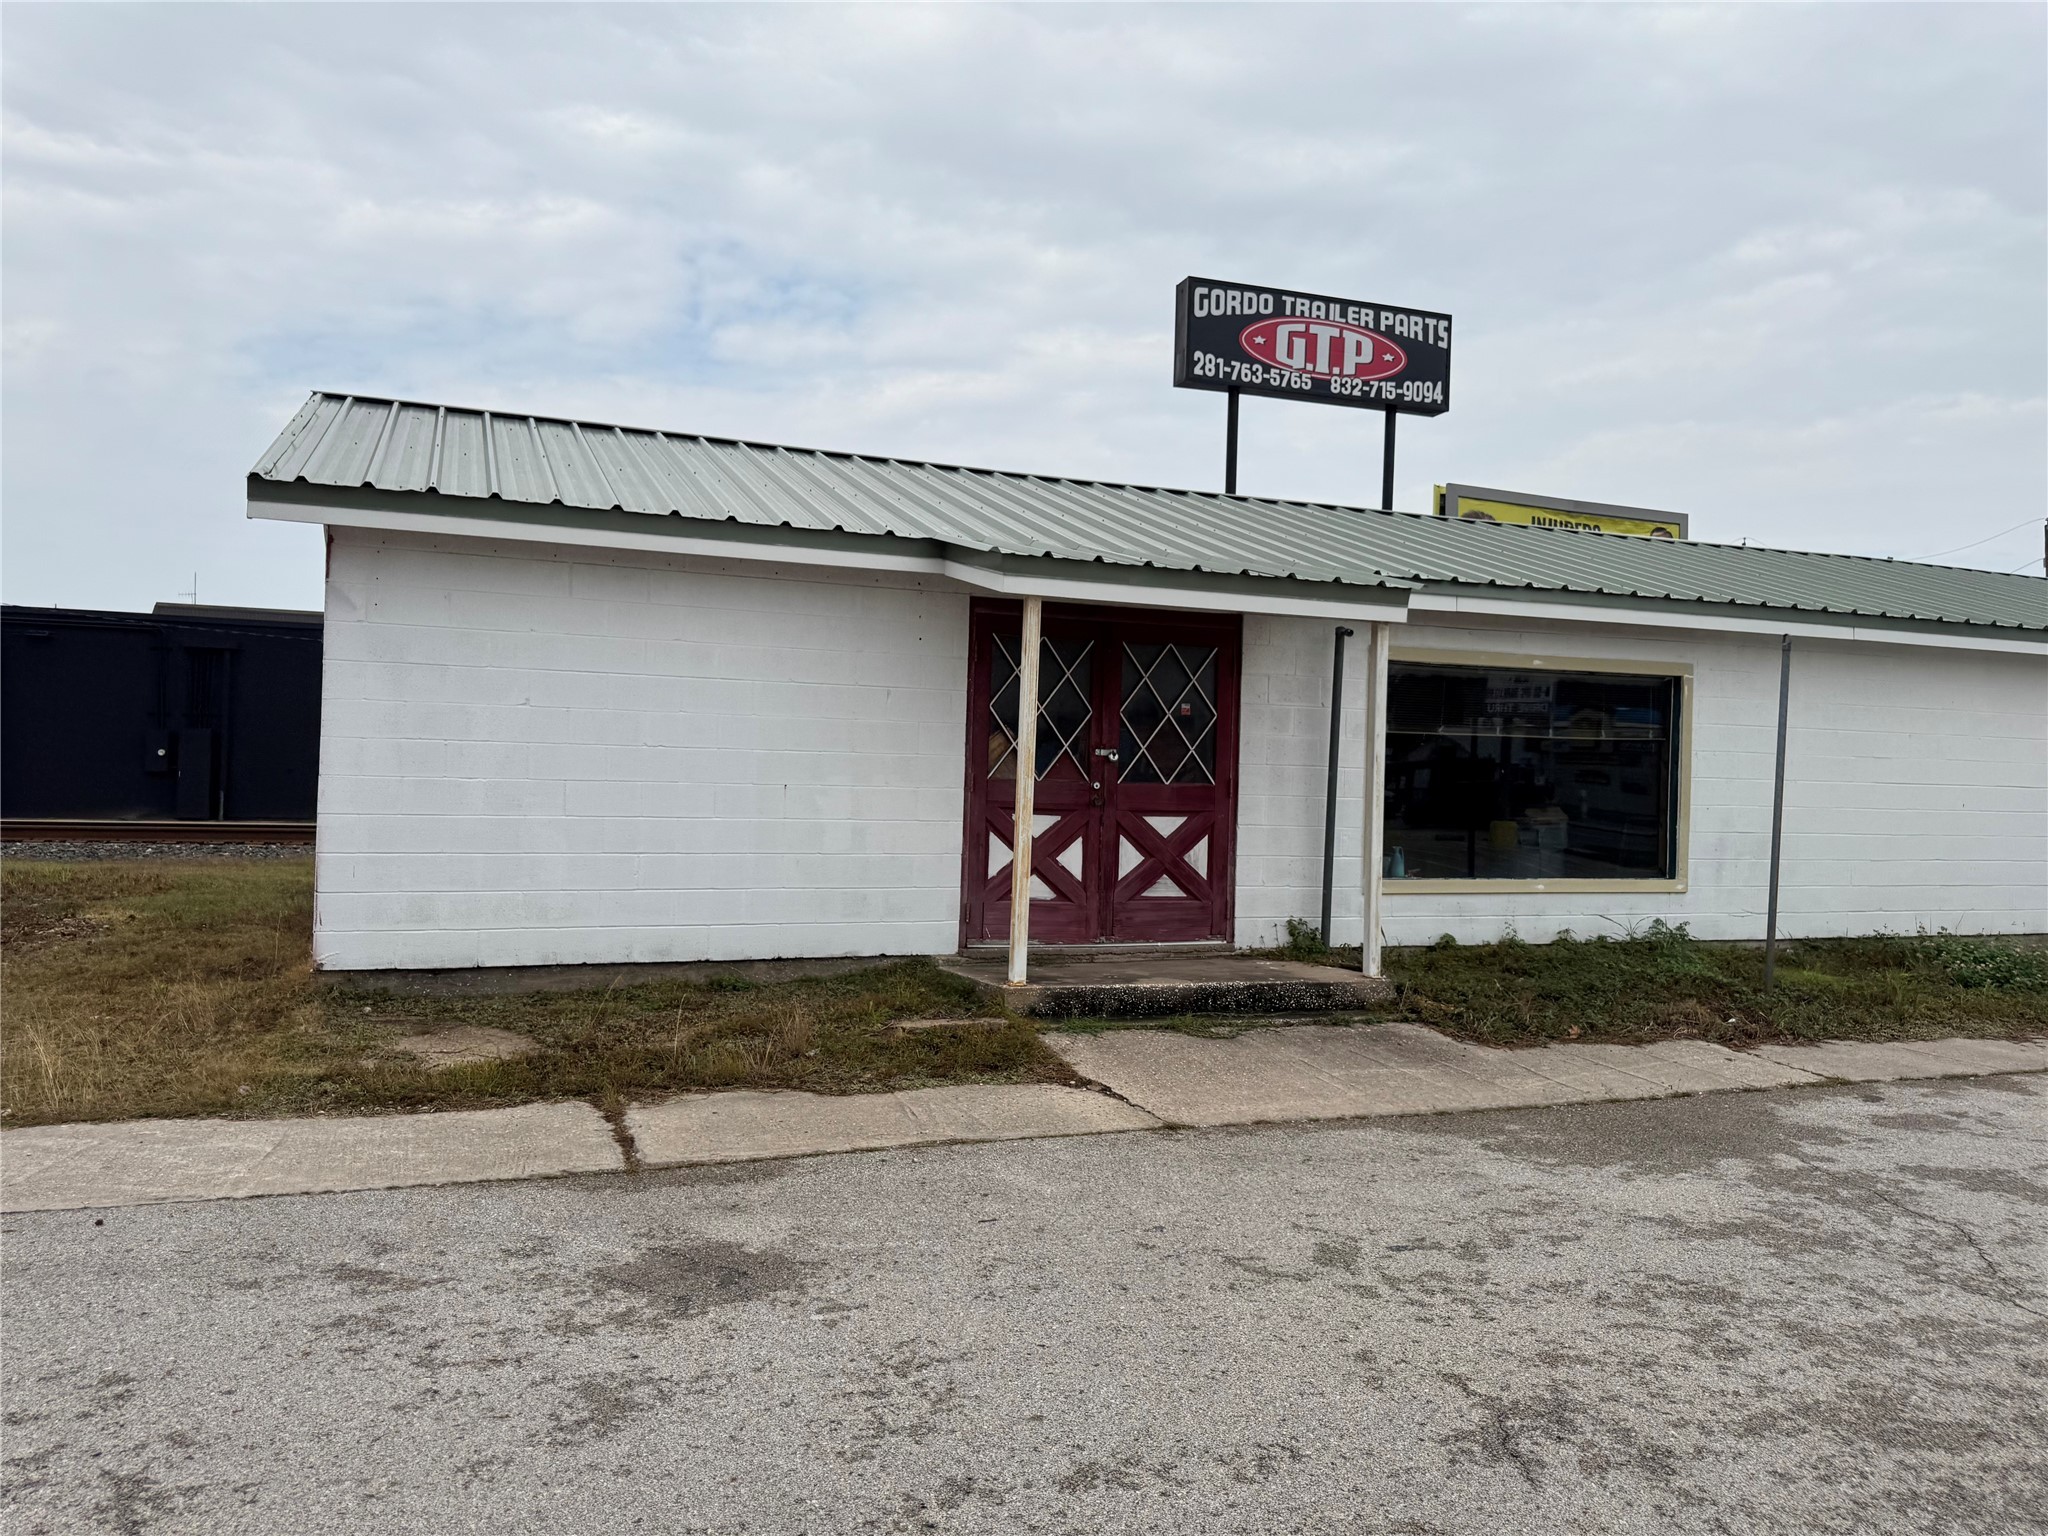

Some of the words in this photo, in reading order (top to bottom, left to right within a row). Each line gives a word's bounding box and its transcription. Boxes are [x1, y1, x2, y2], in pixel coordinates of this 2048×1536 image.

[1194, 287, 1274, 318] GORDO
[1282, 296, 1374, 329] TRAILER
[1380, 311, 1449, 349] PARTS
[1193, 351, 1312, 390] 281-763-5765
[1330, 375, 1443, 404] 832-715-9094
